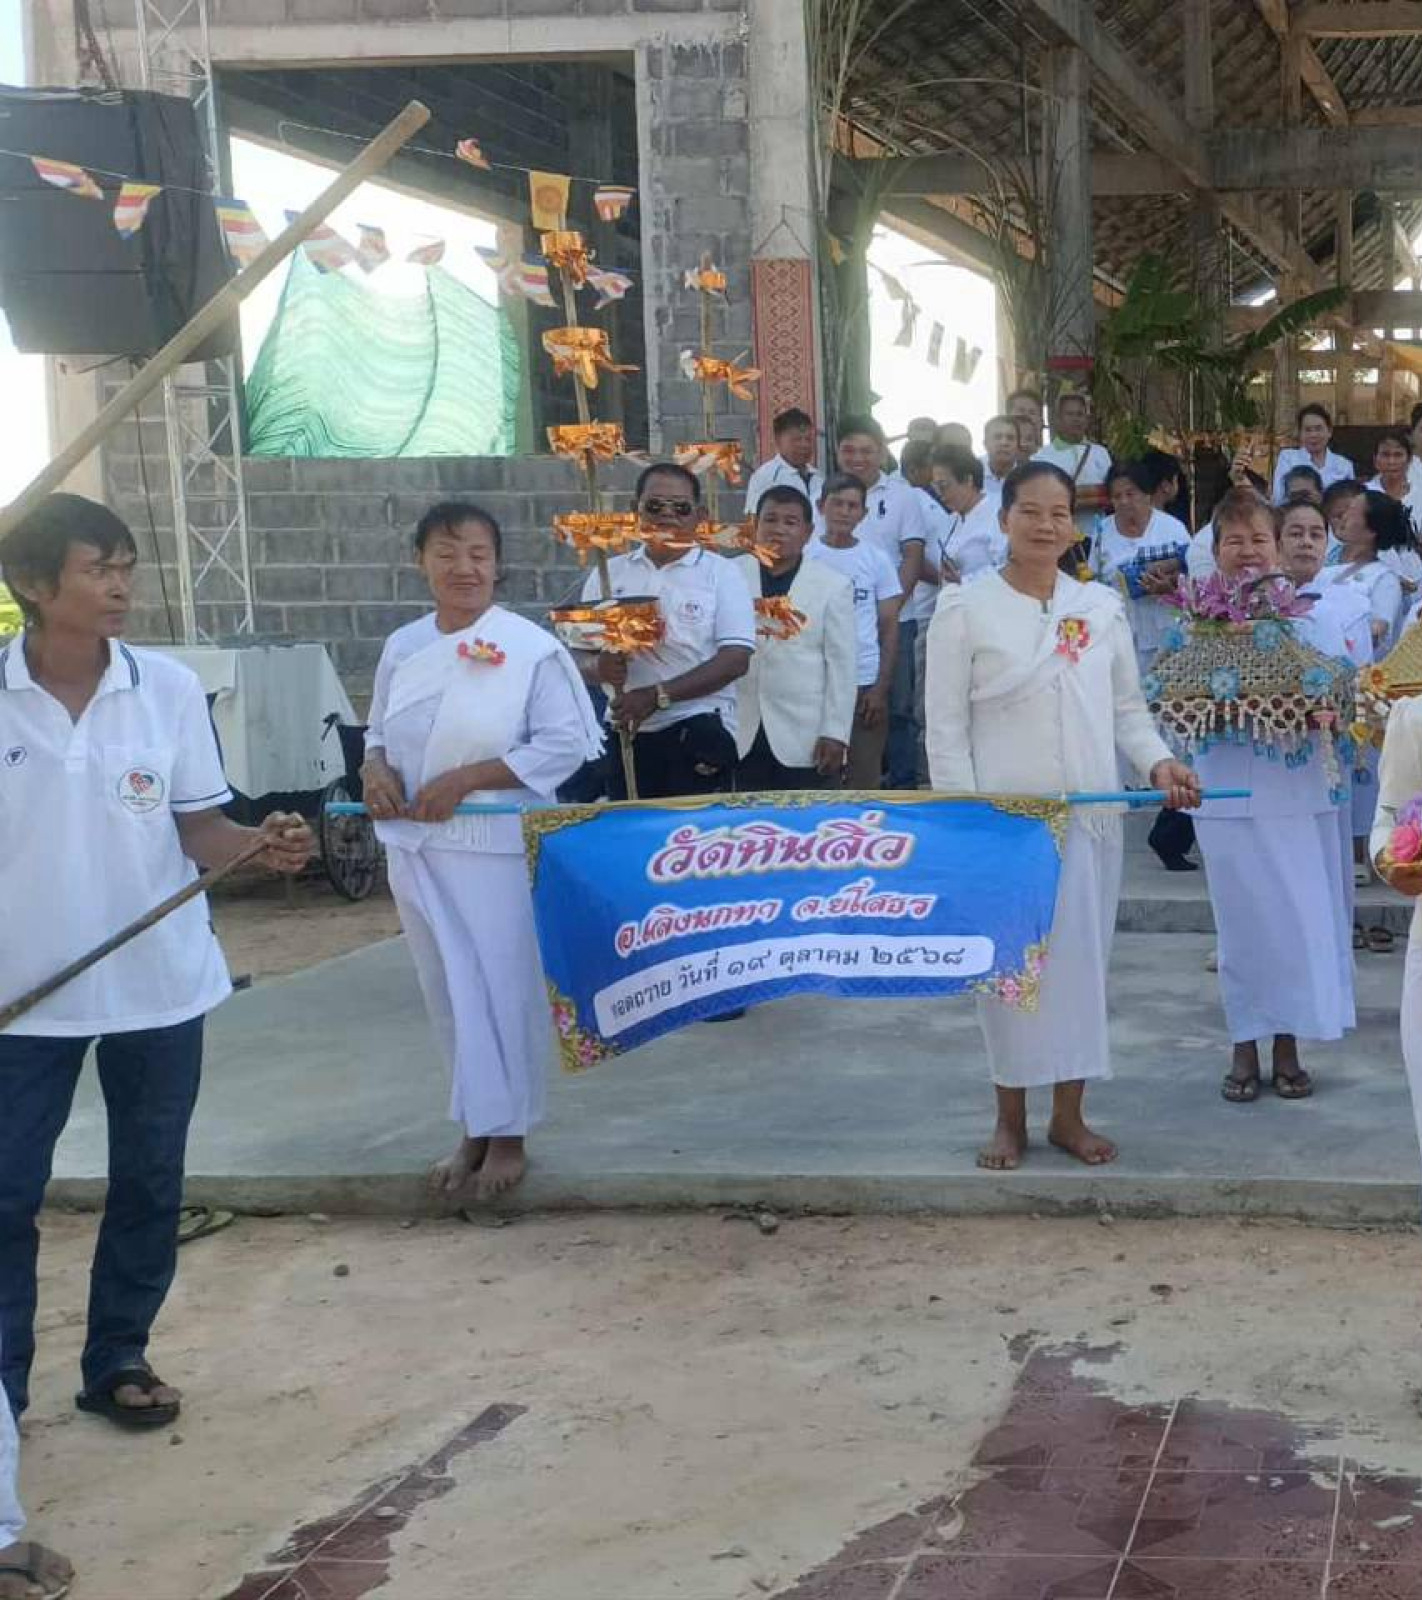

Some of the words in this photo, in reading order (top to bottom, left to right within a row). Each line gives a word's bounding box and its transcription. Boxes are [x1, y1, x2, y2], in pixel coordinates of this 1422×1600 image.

[668, 950, 720, 988] วันที่
[727, 949, 772, 976] ๑๙
[779, 947, 859, 972] ตุลาคม
[870, 946, 966, 966] ๒๕๖๘
